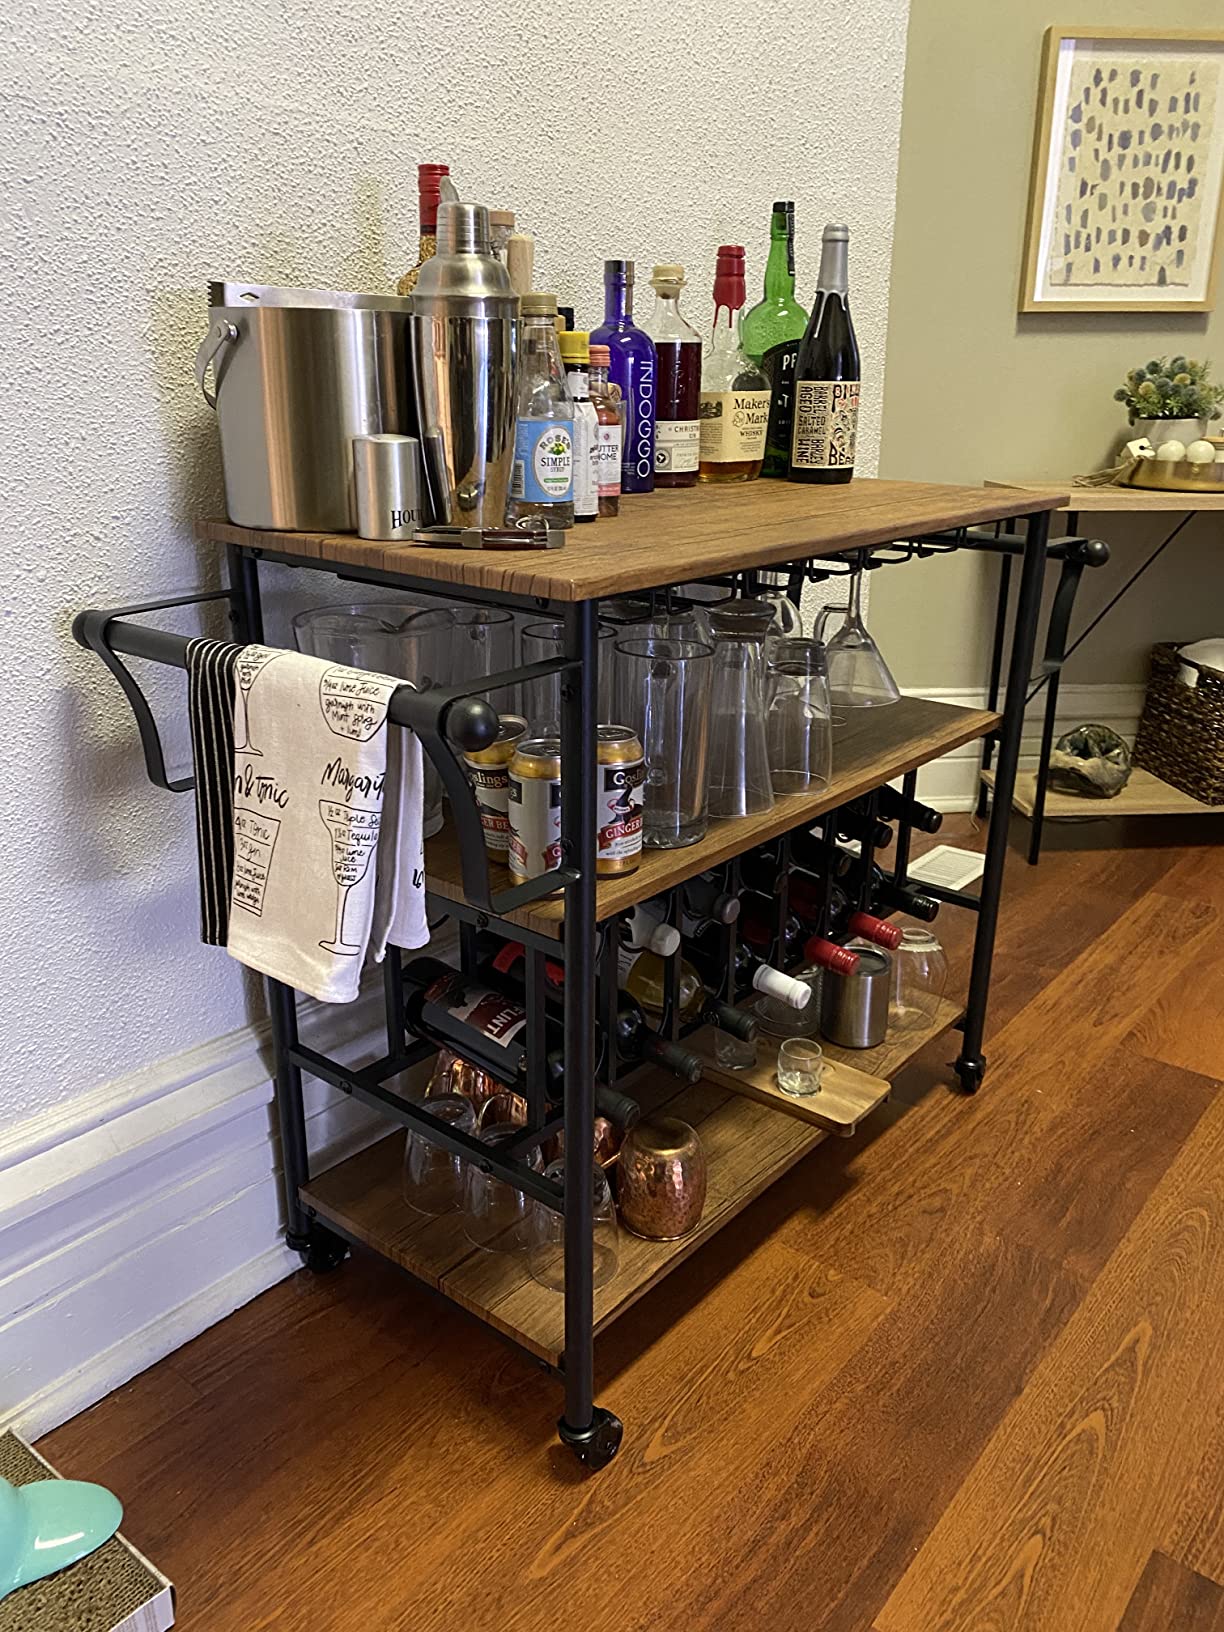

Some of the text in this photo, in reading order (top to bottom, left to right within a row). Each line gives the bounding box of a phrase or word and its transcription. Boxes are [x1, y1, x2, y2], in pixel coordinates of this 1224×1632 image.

[799, 387, 813, 413] AGED
[637, 360, 654, 478] INDOGGO
[745, 412, 768, 425] Mark
[799, 416, 826, 426] SALTED
[797, 427, 826, 435] CARAMEL
[797, 439, 810, 464] WINE
[541, 457, 570, 466] SIMPLE
[606, 819, 640, 838] GINGER
